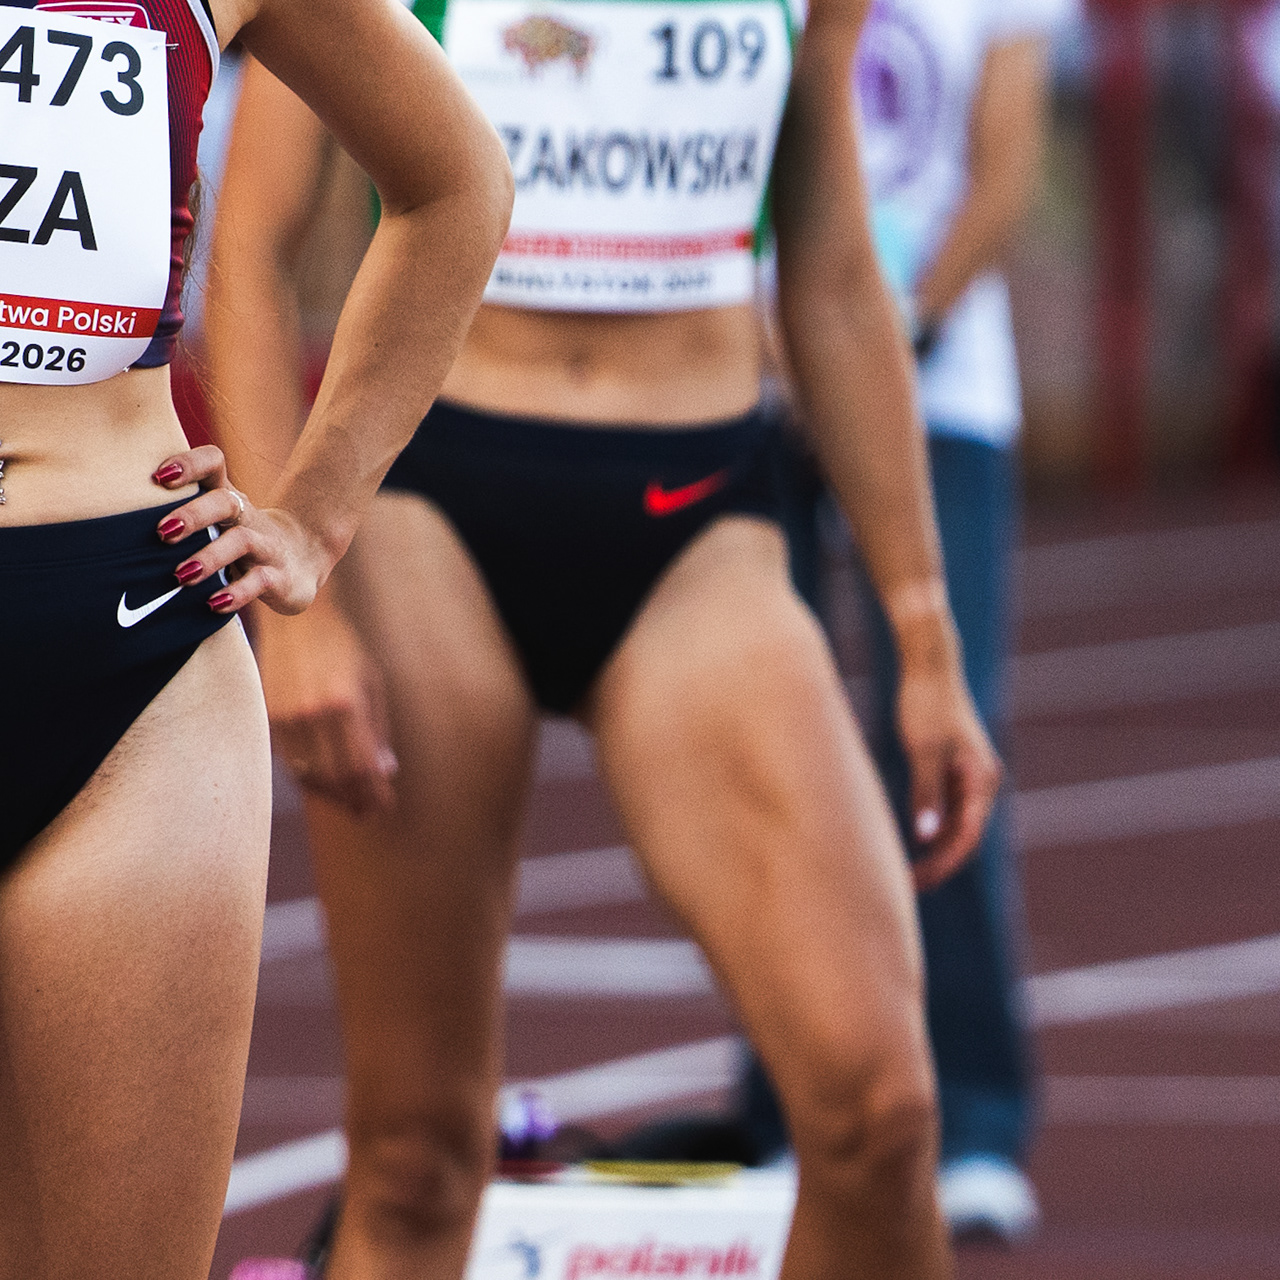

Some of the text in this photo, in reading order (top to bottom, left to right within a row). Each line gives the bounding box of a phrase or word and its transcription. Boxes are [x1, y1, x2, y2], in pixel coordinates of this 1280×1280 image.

[651, 19, 767, 85] 109
[57, 306, 138, 334] Polski
[0, 341, 88, 373] 2026
